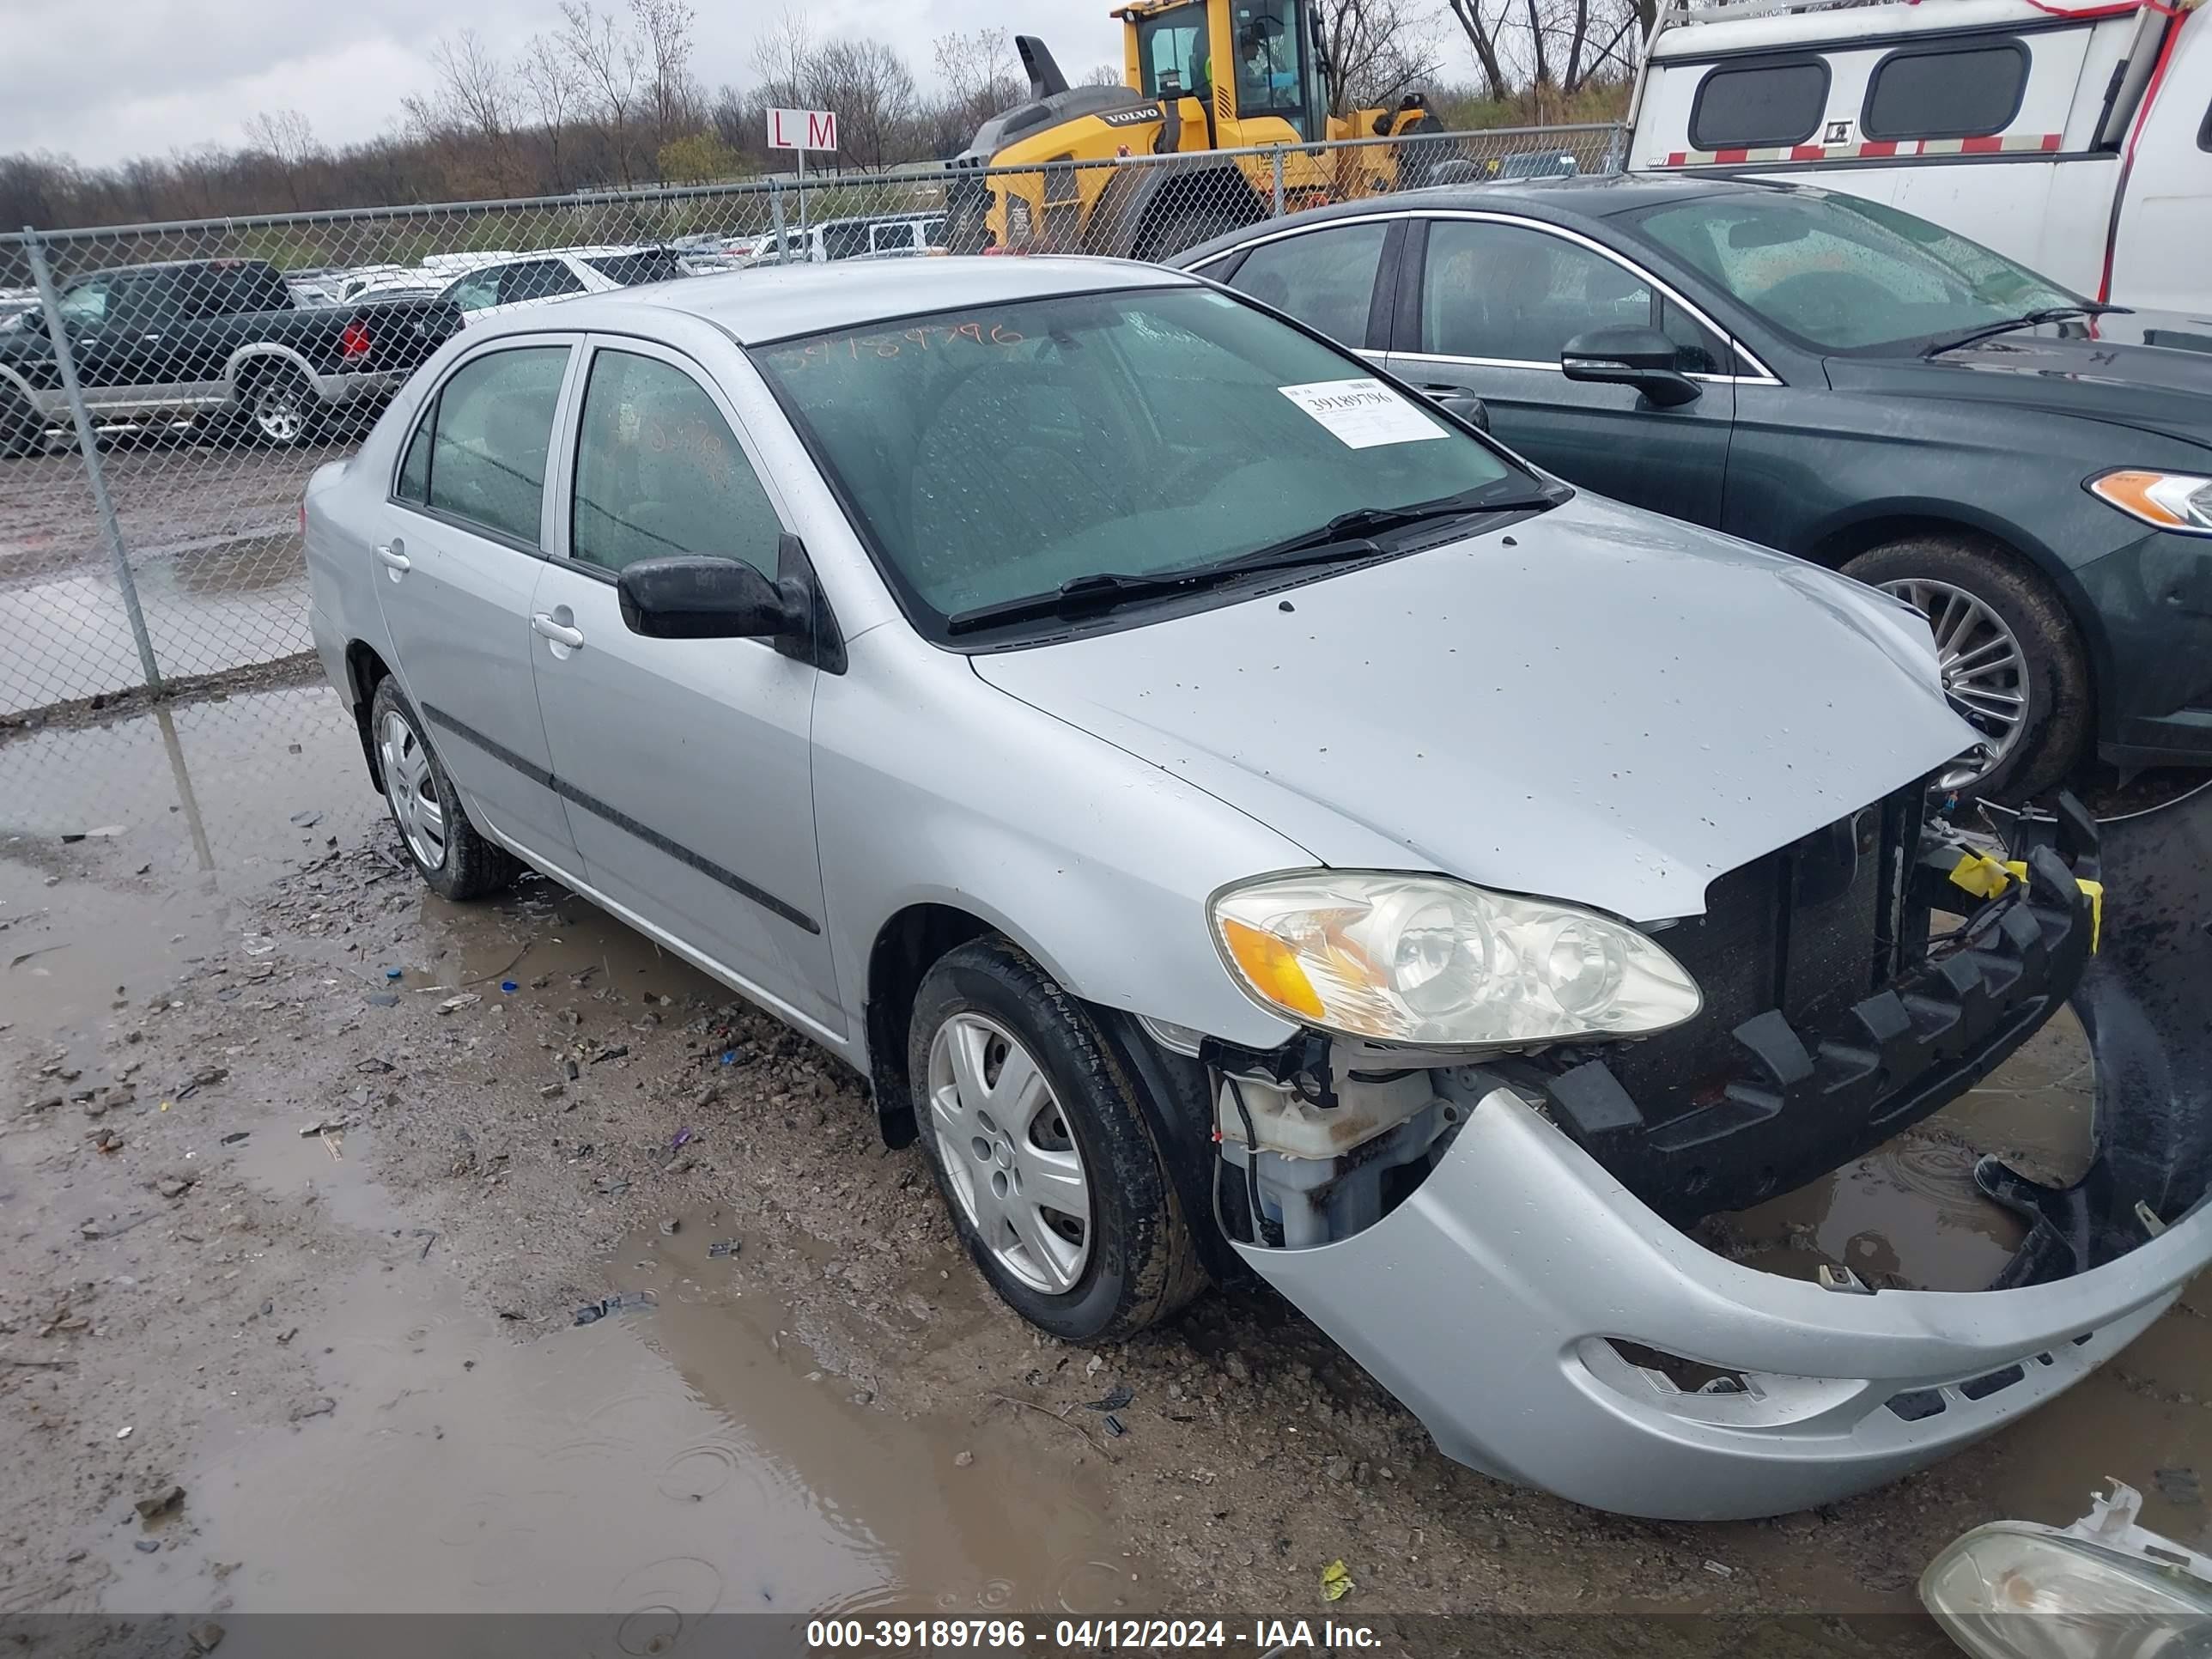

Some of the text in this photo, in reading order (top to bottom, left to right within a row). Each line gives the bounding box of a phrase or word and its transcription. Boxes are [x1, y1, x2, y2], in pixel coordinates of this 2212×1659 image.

[1105, 108, 1158, 123] VOLVO
[775, 110, 835, 149] L M
[1307, 392, 1393, 411] 39189796
